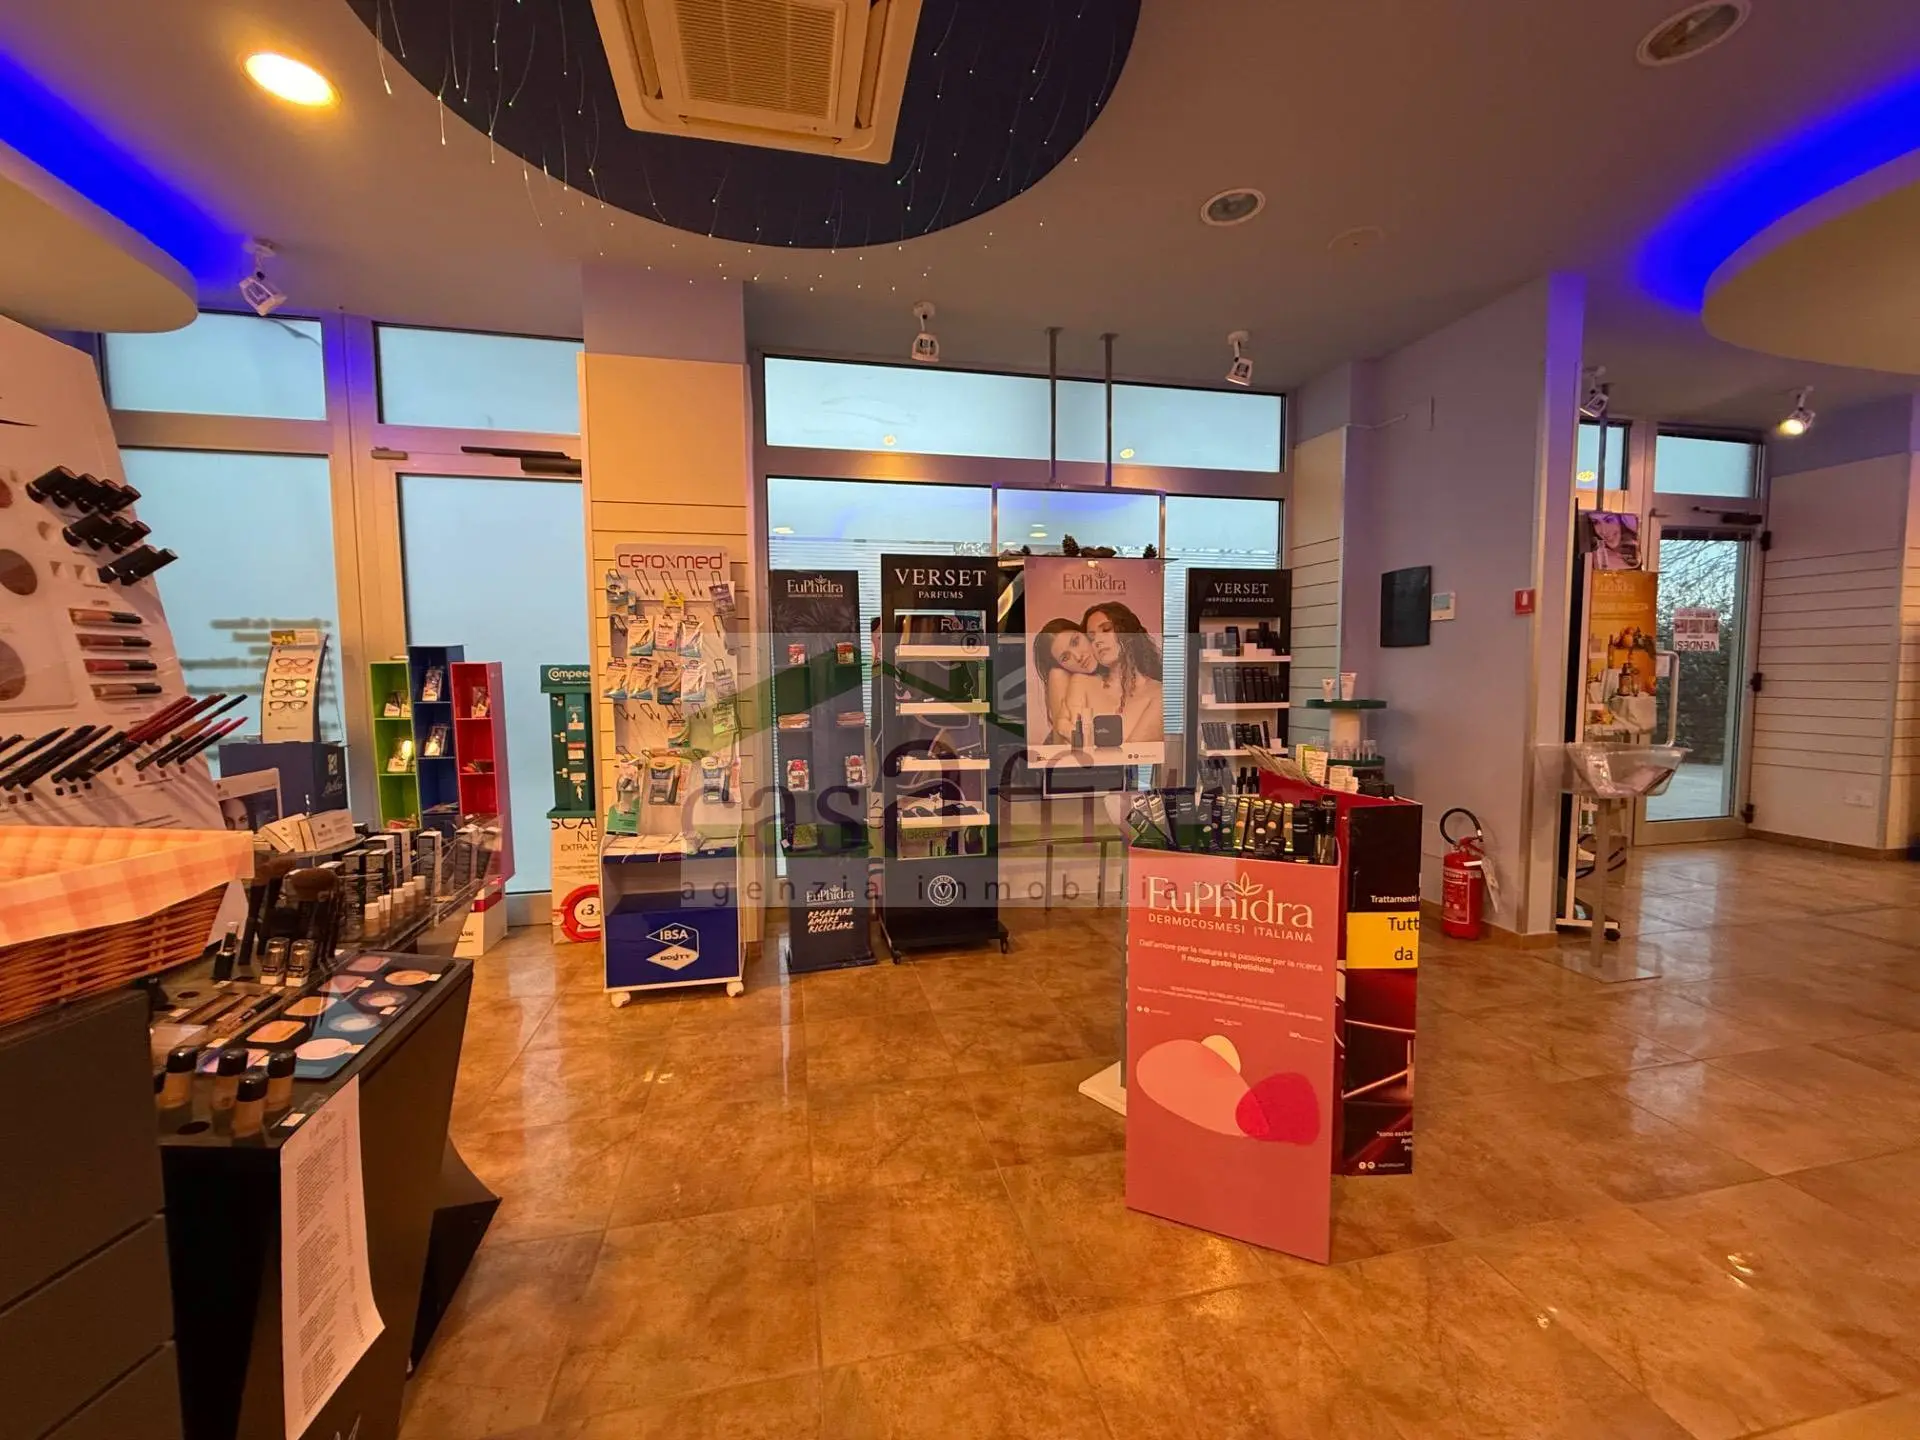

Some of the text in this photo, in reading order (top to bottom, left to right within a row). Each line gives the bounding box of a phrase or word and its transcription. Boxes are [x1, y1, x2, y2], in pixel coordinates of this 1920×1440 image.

[618, 552, 722, 570] ceroxmed
[894, 568, 987, 587] VERSET
[1062, 573, 1127, 590] EuPhidra
[787, 579, 844, 593] EuPhidra
[1214, 582, 1270, 594] VERSET
[918, 591, 964, 599] PARFUMS
[806, 888, 855, 901] EuPhidra
[1370, 895, 1417, 904] Trattamenti
[1147, 875, 1314, 930] EuPhidra
[807, 907, 853, 919] REGALARE
[807, 917, 839, 926] AMARE
[1148, 913, 1314, 943] DERMOCOSMESI ITALIANA
[660, 929, 689, 941] IBSA
[1177, 945, 1189, 953] per
[1190, 945, 1197, 953] la
[1230, 951, 1237, 959] la
[1238, 953, 1272, 964] passione
[1273, 958, 1286, 968] per
[1287, 959, 1295, 967] la
[1394, 946, 1414, 961] da
[1187, 956, 1211, 965] nuovo
[1211, 960, 1232, 969] gesto
[1233, 962, 1275, 974] quotidiano
